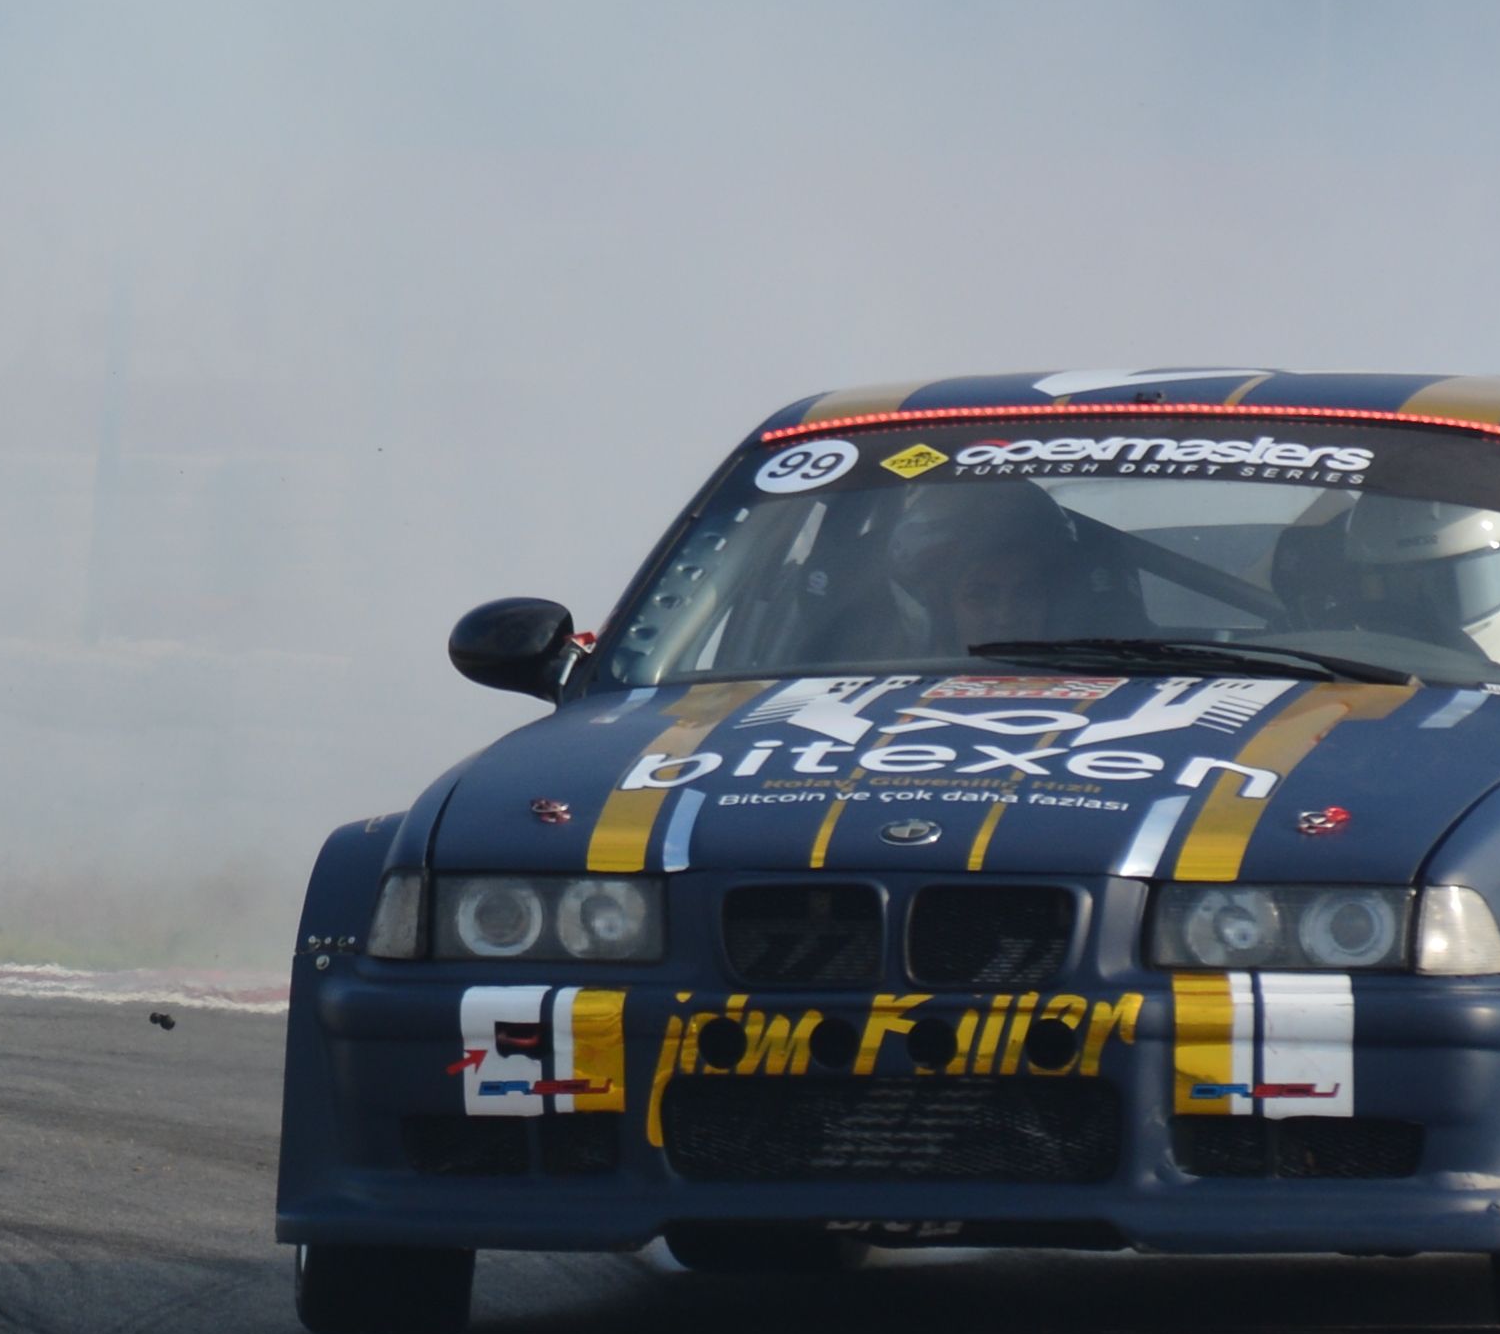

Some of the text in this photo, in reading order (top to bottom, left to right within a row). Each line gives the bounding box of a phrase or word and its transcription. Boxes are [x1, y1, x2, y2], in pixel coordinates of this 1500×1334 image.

[766, 450, 846, 480] 99
[955, 462, 1367, 485] TURKISH DRIFT SERIES
[620, 738, 1283, 801] bitexen
[717, 789, 1131, 812] Bitcoin ve çok daha fazlası
